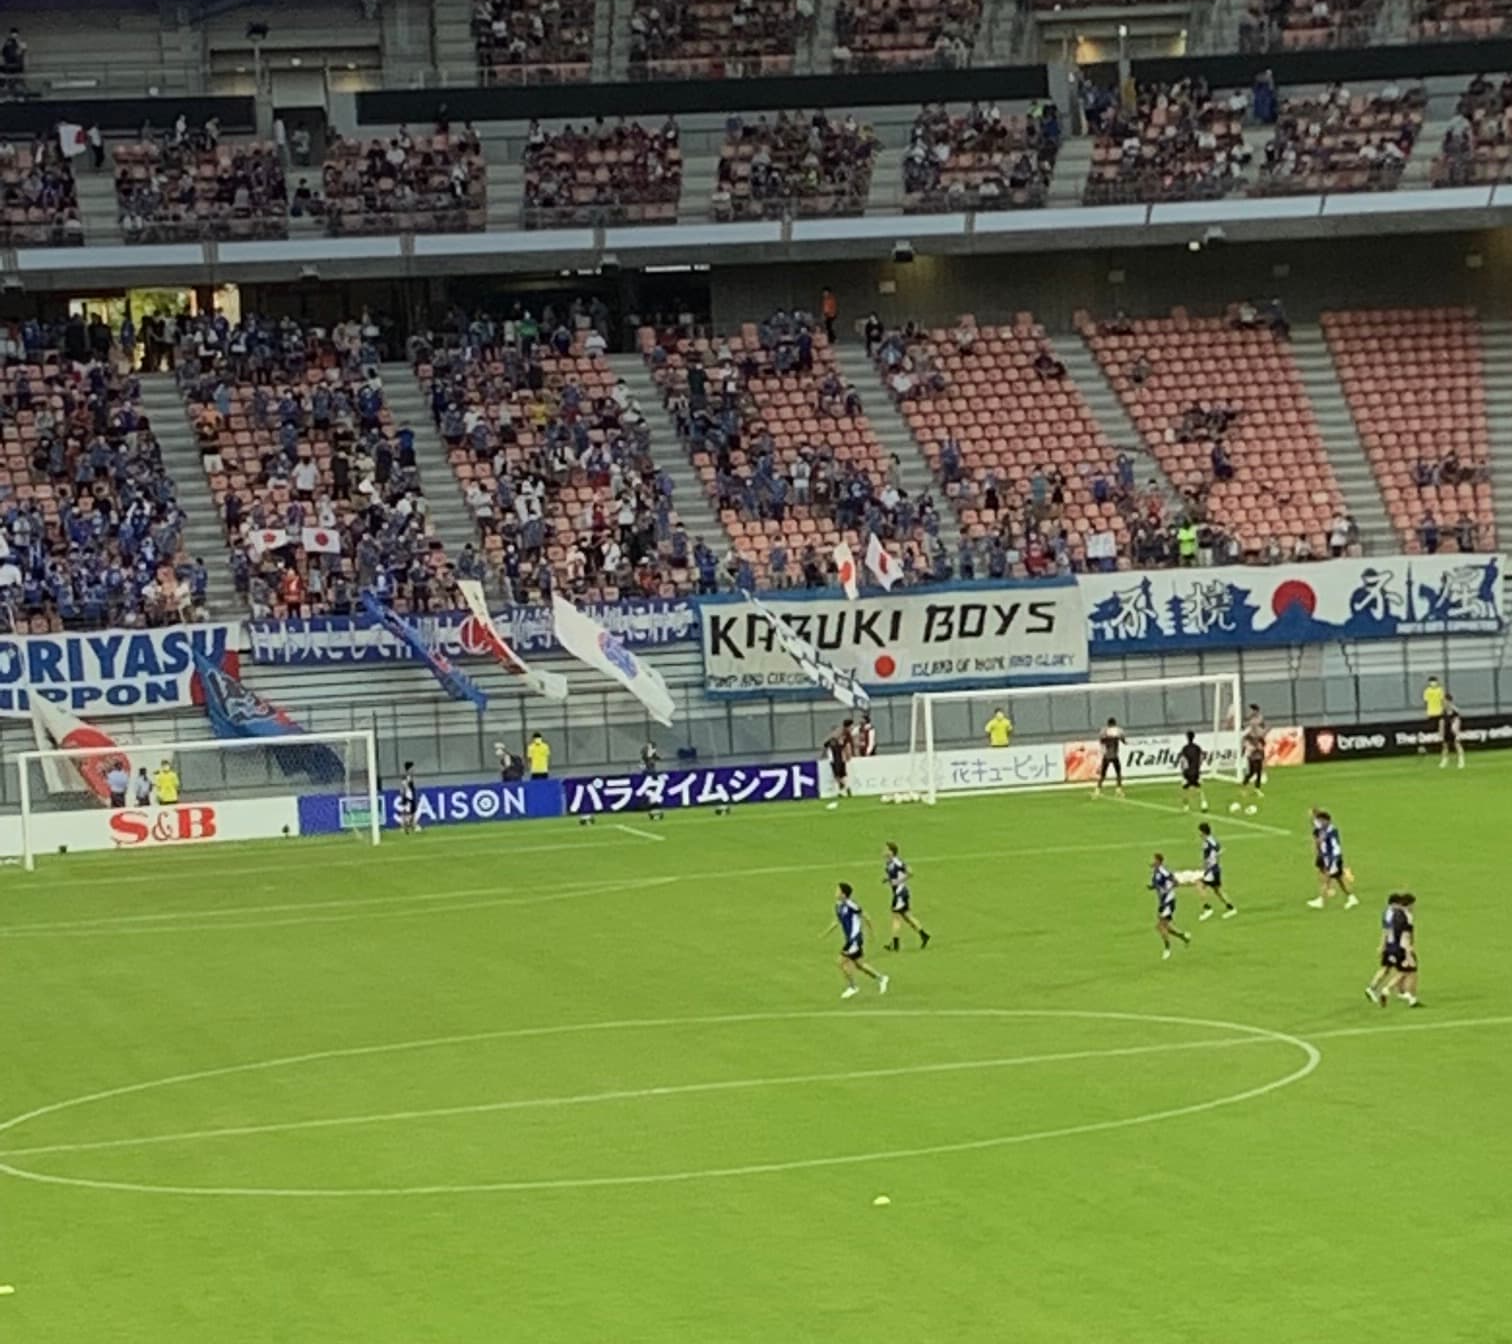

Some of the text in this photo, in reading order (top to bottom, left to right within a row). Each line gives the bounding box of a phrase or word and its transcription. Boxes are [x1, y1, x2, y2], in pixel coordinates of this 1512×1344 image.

[923, 601, 1056, 643] BOYS
[1337, 730, 1386, 751] brave
[569, 764, 816, 813] パラダイムシフト
[110, 806, 216, 846] S&B
